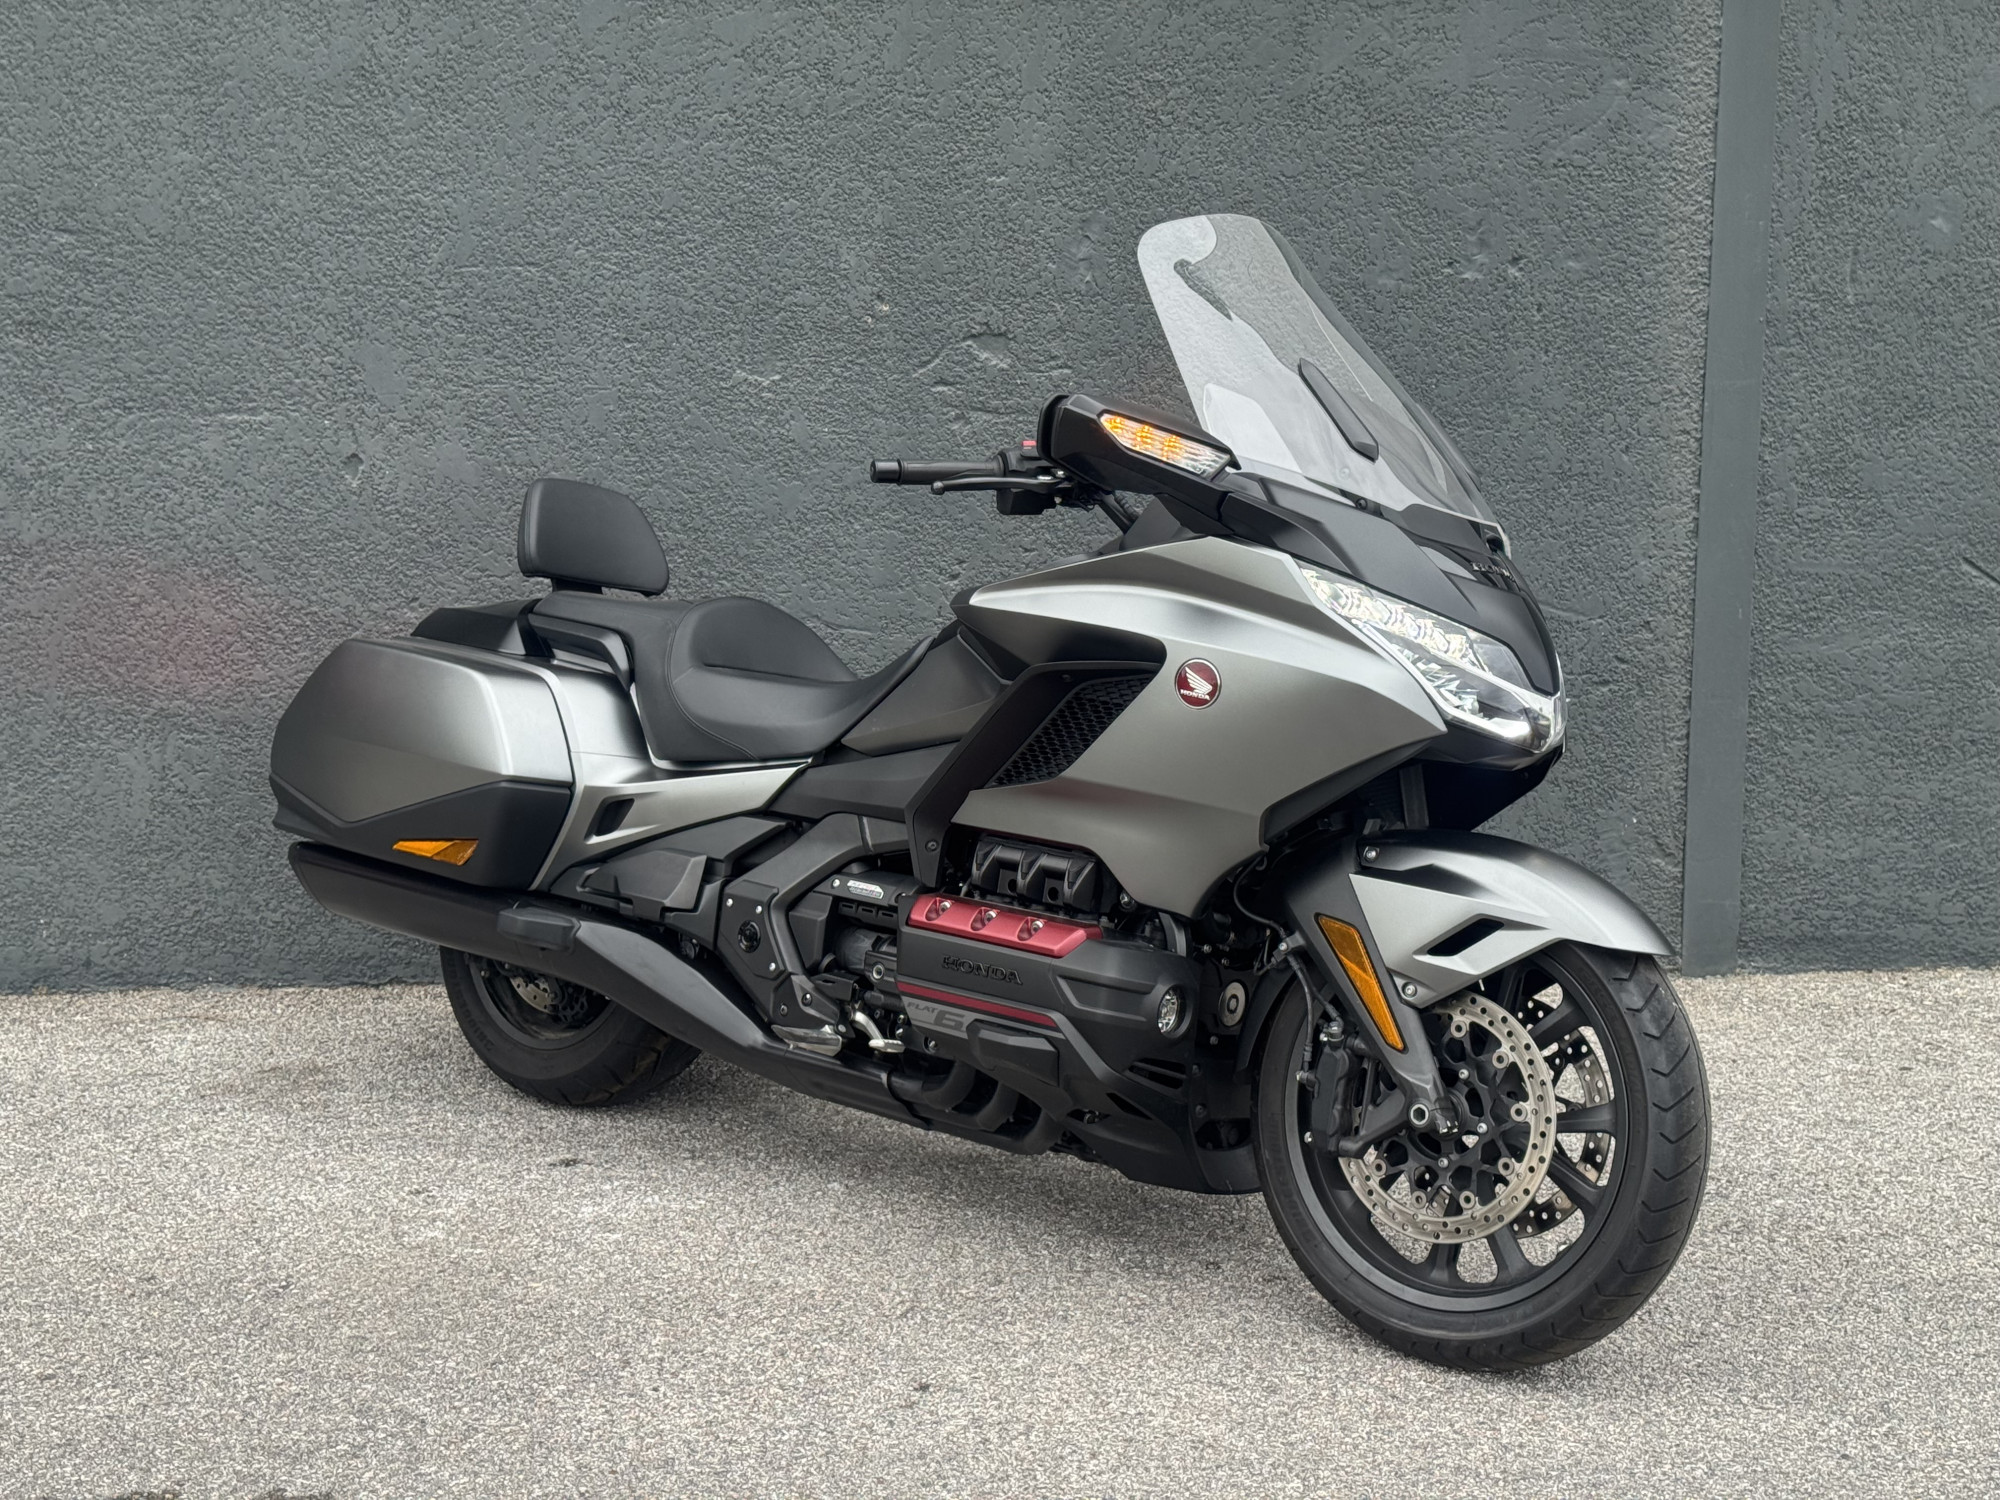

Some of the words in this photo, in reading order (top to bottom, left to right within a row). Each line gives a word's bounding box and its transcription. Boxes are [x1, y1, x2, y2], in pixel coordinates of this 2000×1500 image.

[1180, 689, 1211, 701] HONDA
[942, 955, 1024, 986] HONDA
[906, 1001, 939, 1015] FLAT
[933, 1009, 966, 1031] 6
